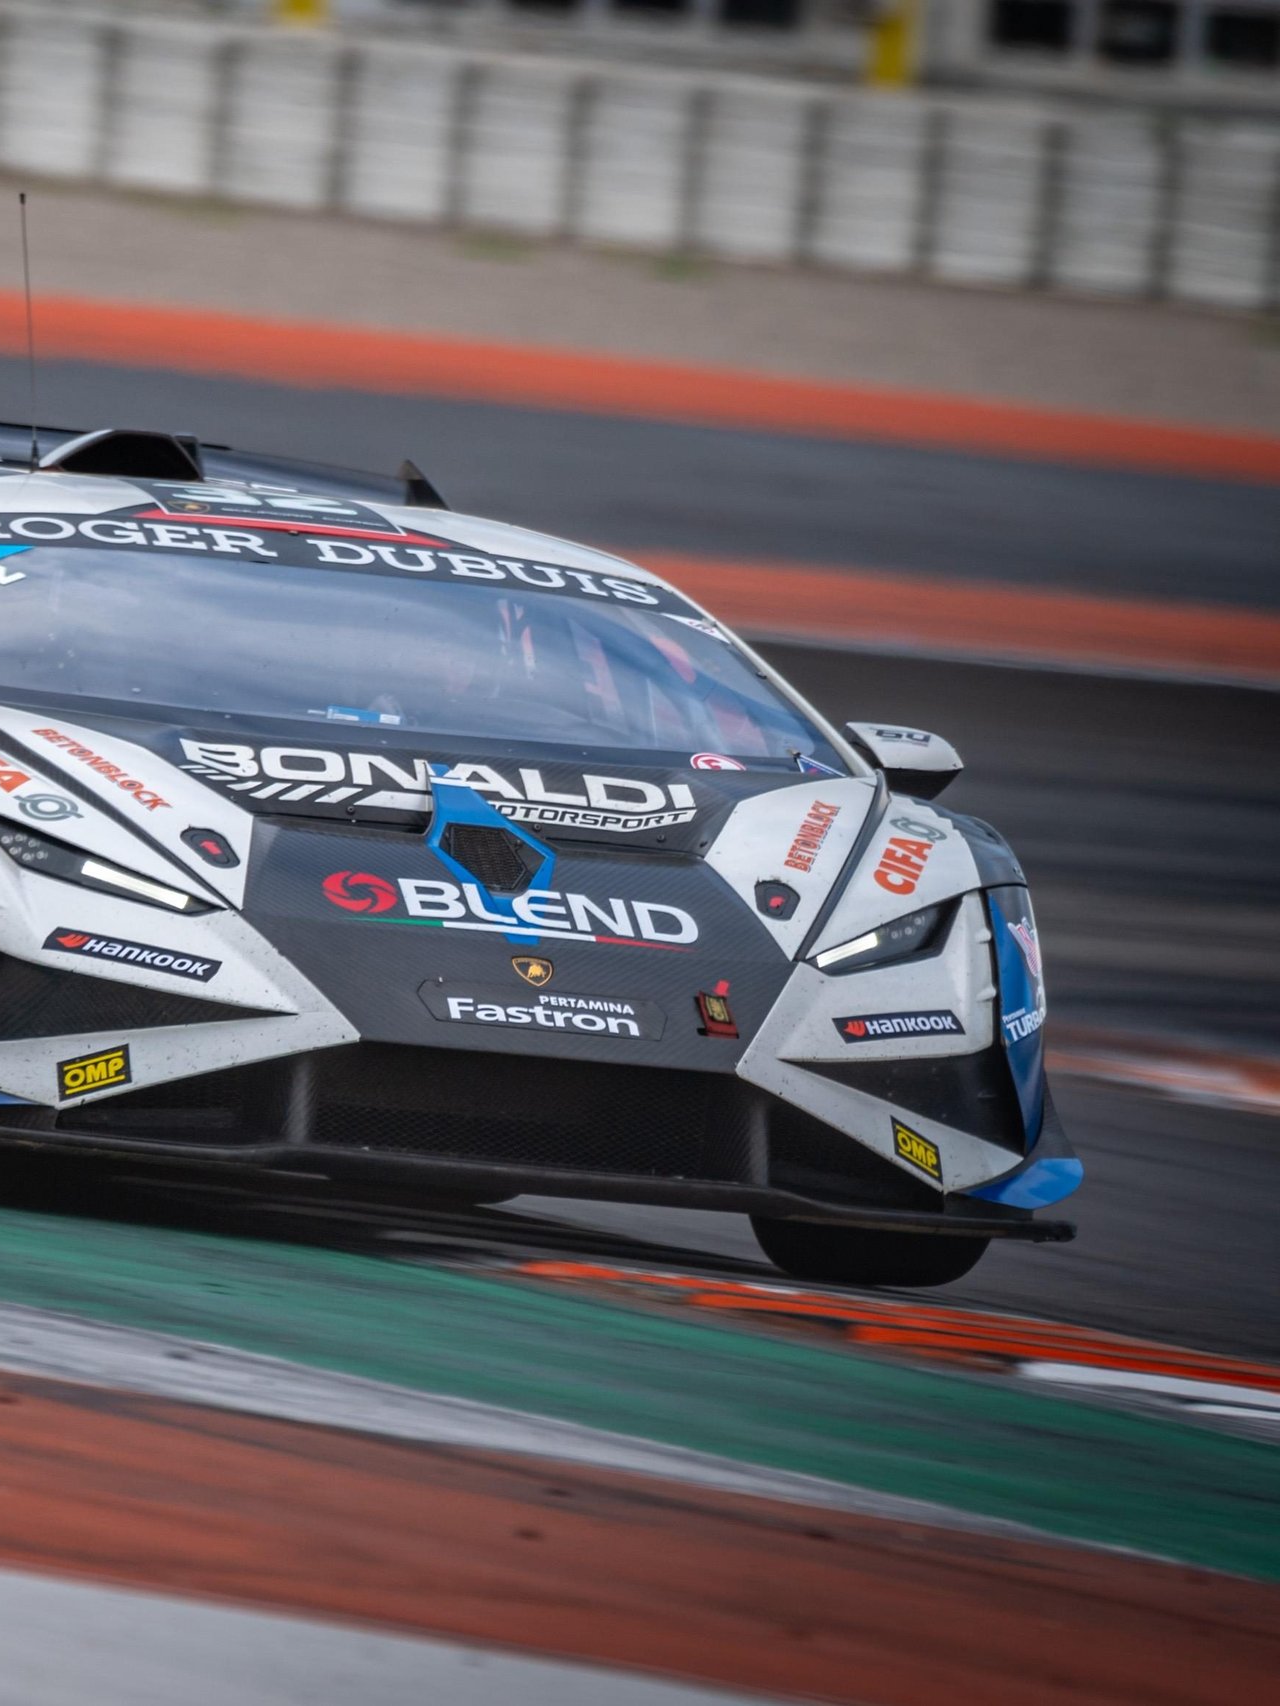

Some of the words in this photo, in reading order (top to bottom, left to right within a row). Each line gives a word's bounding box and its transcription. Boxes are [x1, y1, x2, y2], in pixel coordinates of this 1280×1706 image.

[307, 539, 660, 606] DUBUIS
[31, 728, 173, 812] BETONBLOCK
[180, 738, 697, 814] BONALDI
[784, 800, 841, 874] BETONBLOCK
[874, 837, 936, 896] CIFA
[397, 878, 699, 944] BLEND
[446, 997, 641, 1037] Fastron
[538, 995, 636, 1016] PERTAMINA
[64, 1057, 125, 1088] OMP
[897, 1131, 938, 1168] OMP
